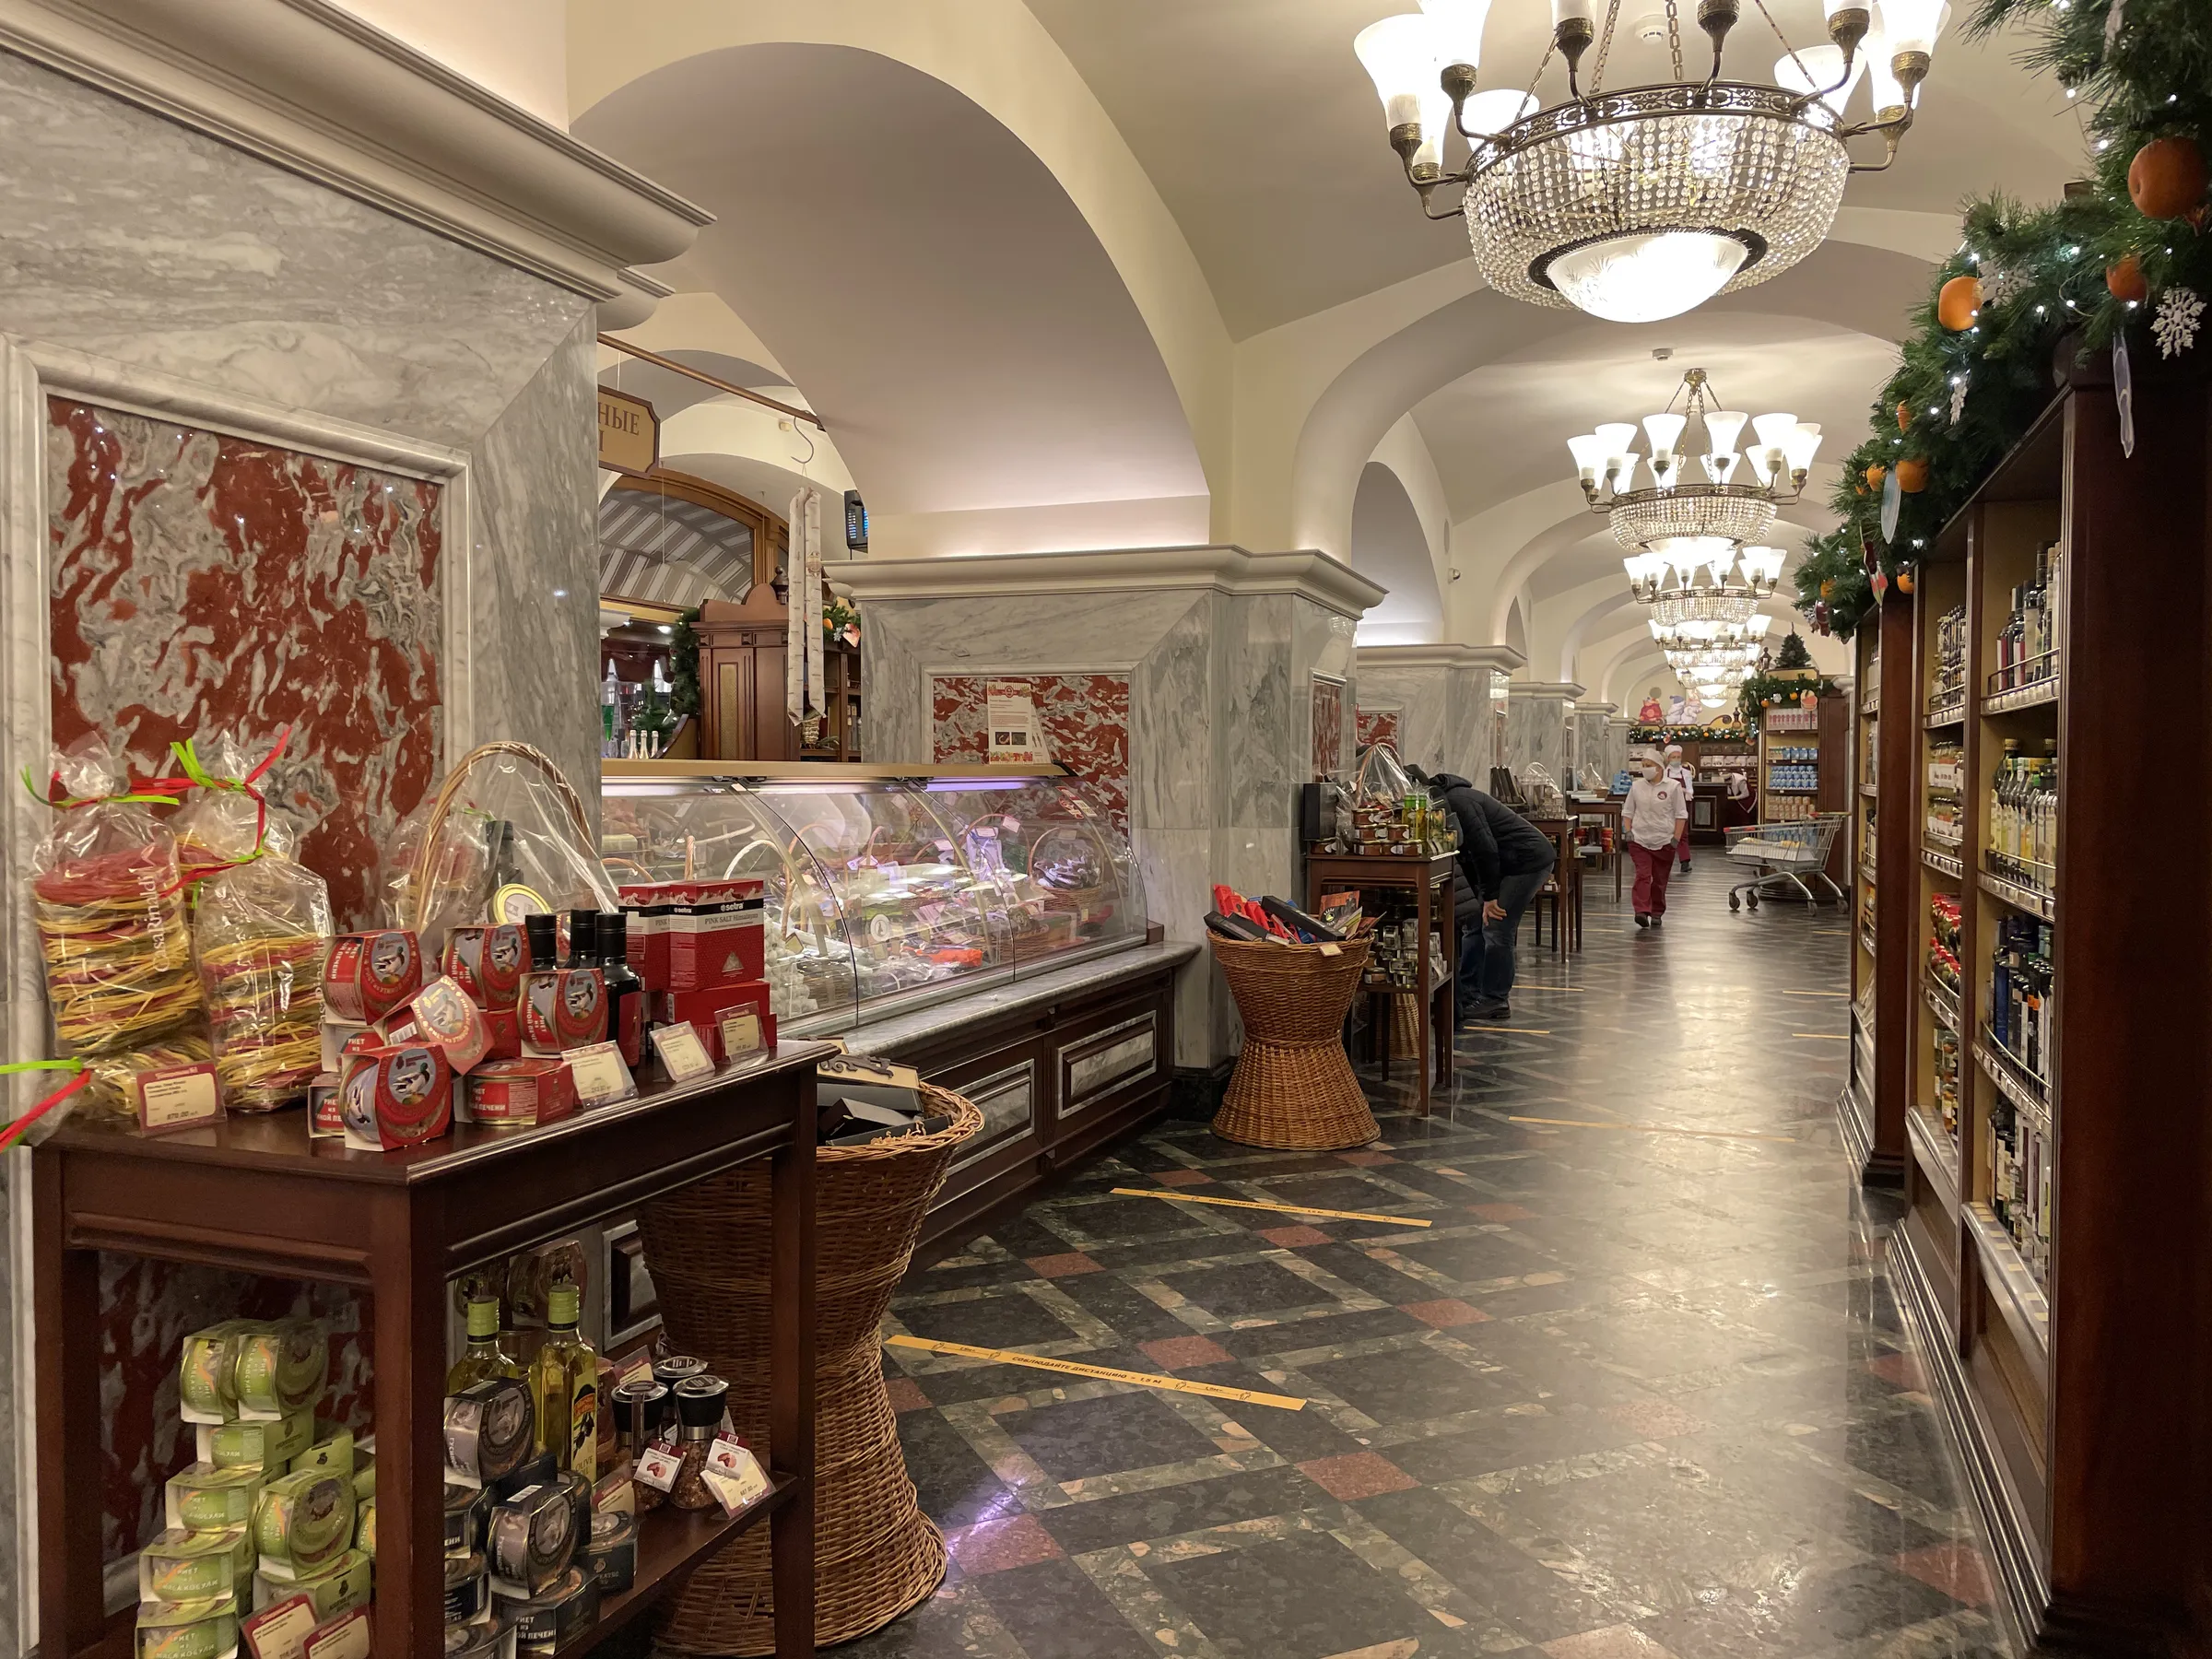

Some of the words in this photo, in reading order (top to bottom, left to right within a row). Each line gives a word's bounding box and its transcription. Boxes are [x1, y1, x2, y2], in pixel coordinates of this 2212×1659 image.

[725, 902, 744, 912] setra
[704, 916, 719, 924] PINK
[331, 951, 344, 979] ПЕЧЕНИ
[1011, 1356, 1070, 1371] СОБЛЮДАЙТЕ
[1070, 1366, 1127, 1380] ДИСТАНЦИЮ
[575, 1454, 594, 1472] OLIVE
[177, 1567, 198, 1575] РИЕТ
[183, 1579, 218, 1592] КОСУЛИ
[515, 1616, 535, 1624] РИЕТ
[172, 1633, 195, 1642] РИЕТ
